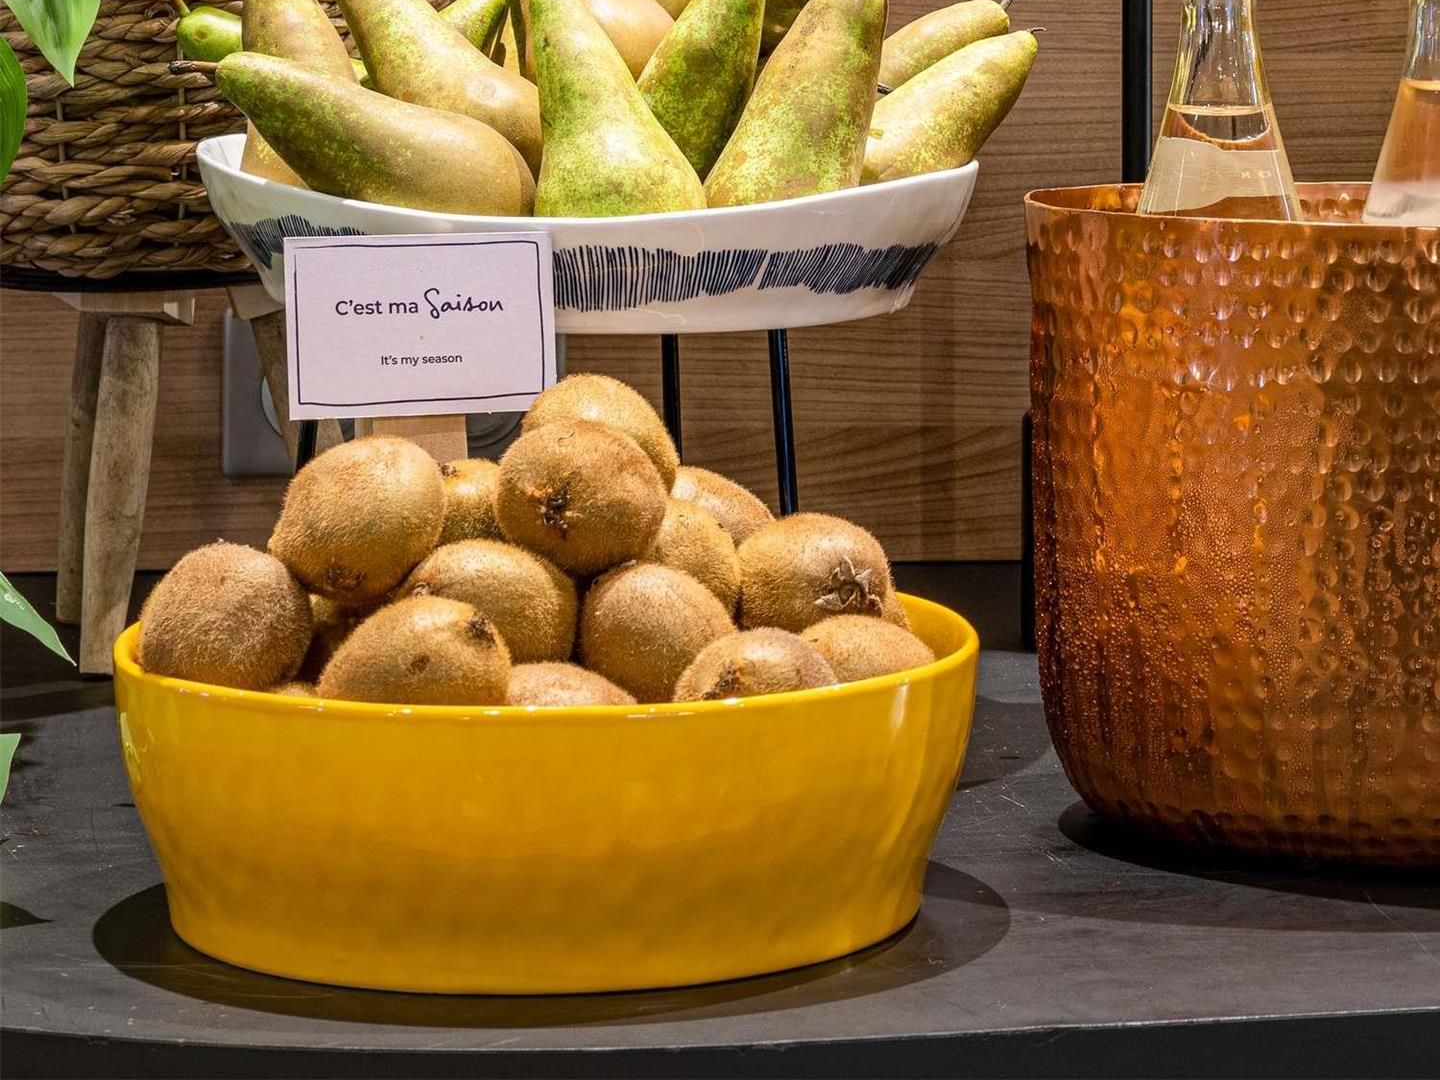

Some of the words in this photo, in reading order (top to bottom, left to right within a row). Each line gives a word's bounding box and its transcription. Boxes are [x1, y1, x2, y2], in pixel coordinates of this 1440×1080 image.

[335, 299, 383, 316] C'est
[388, 300, 419, 315] ma
[423, 287, 504, 320] Saison
[380, 354, 398, 366] It's
[400, 355, 420, 367] my
[421, 353, 463, 365] season
